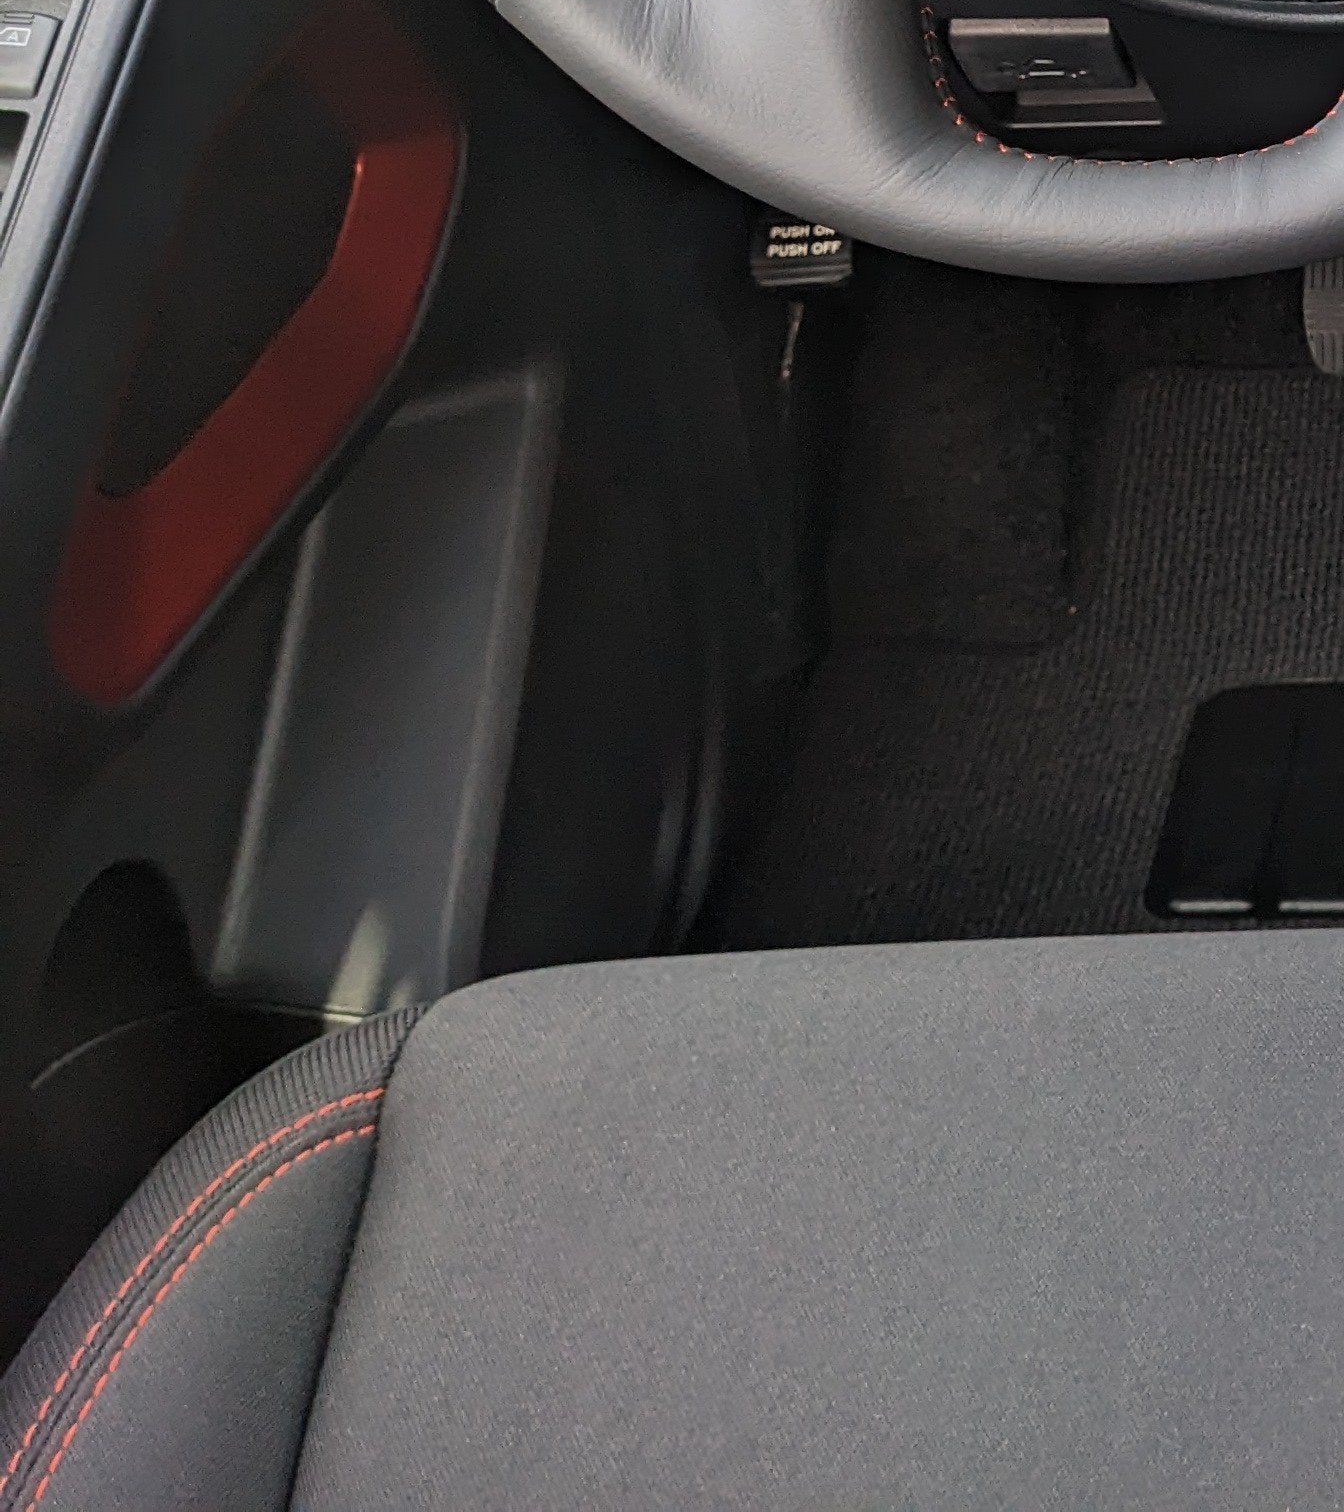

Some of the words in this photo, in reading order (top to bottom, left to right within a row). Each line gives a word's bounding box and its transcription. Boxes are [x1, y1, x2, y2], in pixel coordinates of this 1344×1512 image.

[769, 224, 810, 238] PUSH
[766, 243, 809, 258] PUSH
[811, 240, 842, 255] OFF
